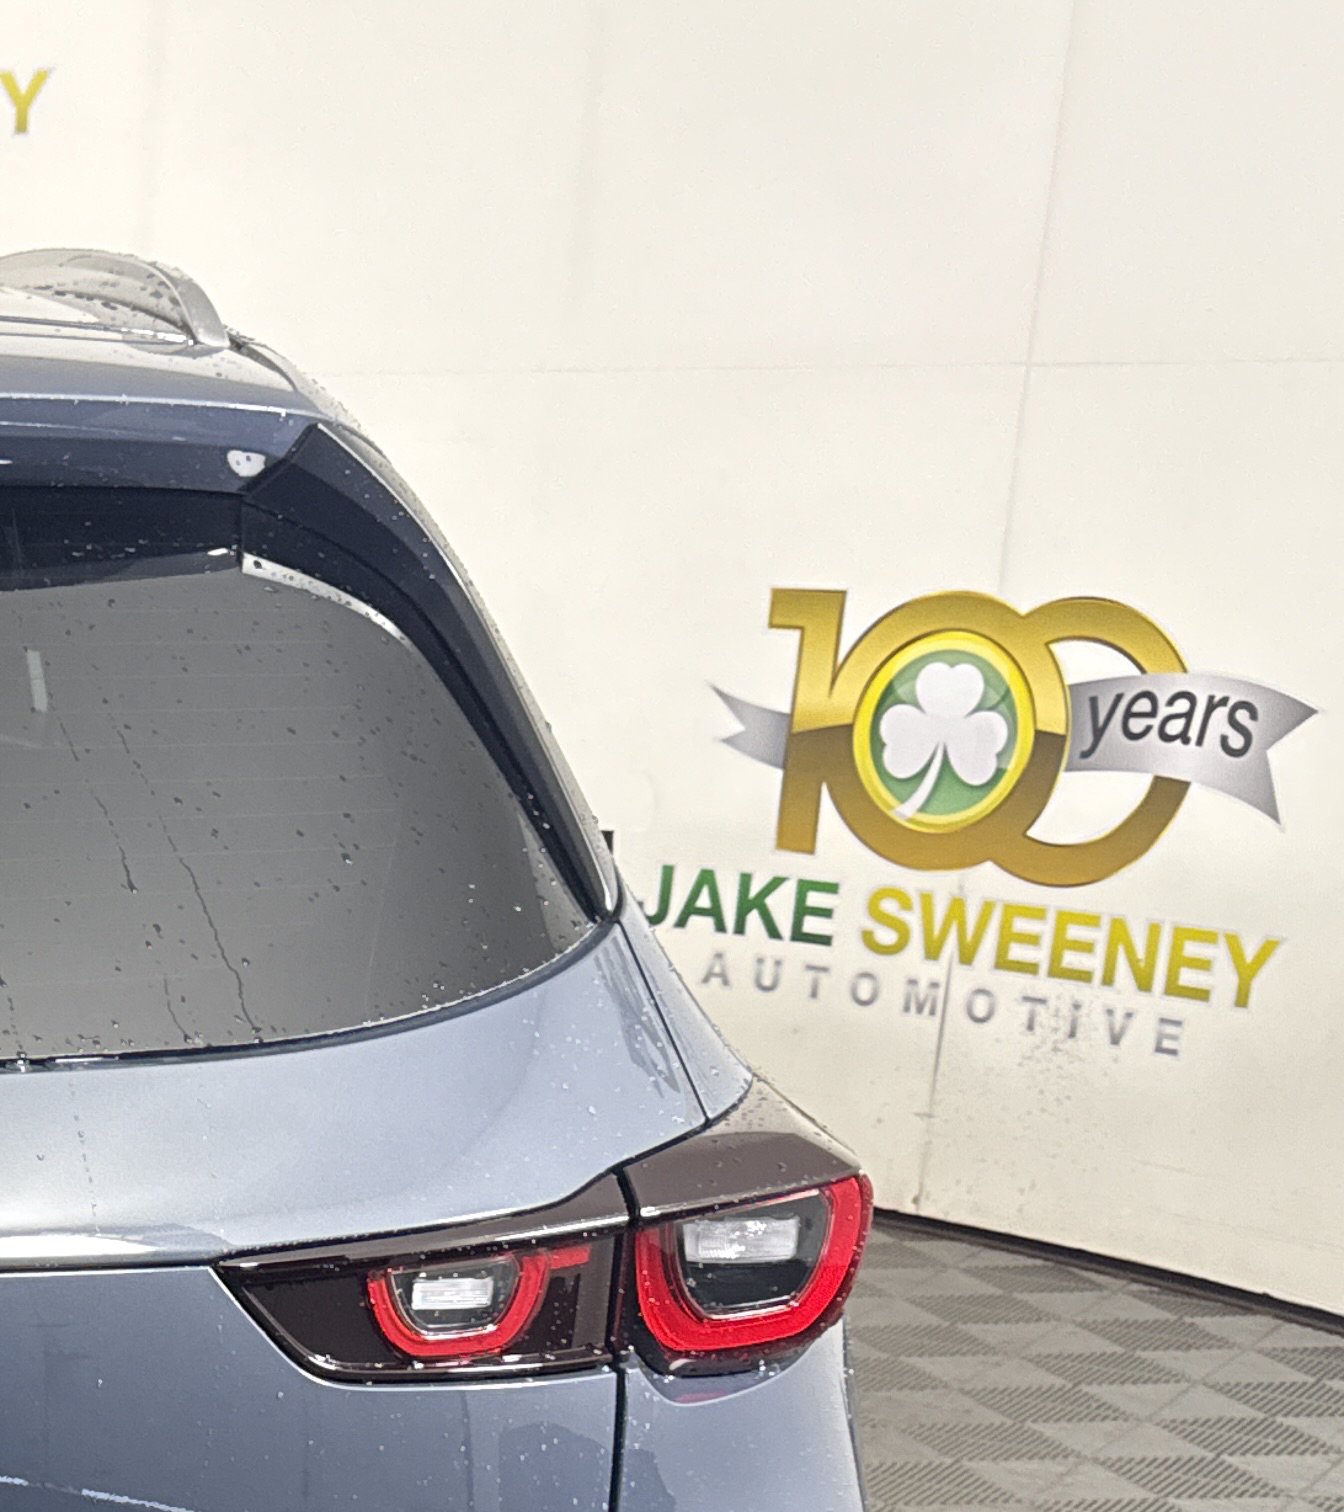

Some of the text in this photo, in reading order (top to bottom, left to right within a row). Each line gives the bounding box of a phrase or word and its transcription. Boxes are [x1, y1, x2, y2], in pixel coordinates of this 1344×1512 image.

[1079, 689, 1260, 760] years
[642, 863, 1280, 1008] JAKE SWEENEY
[701, 952, 1184, 1056] AUTOMOTIVE
